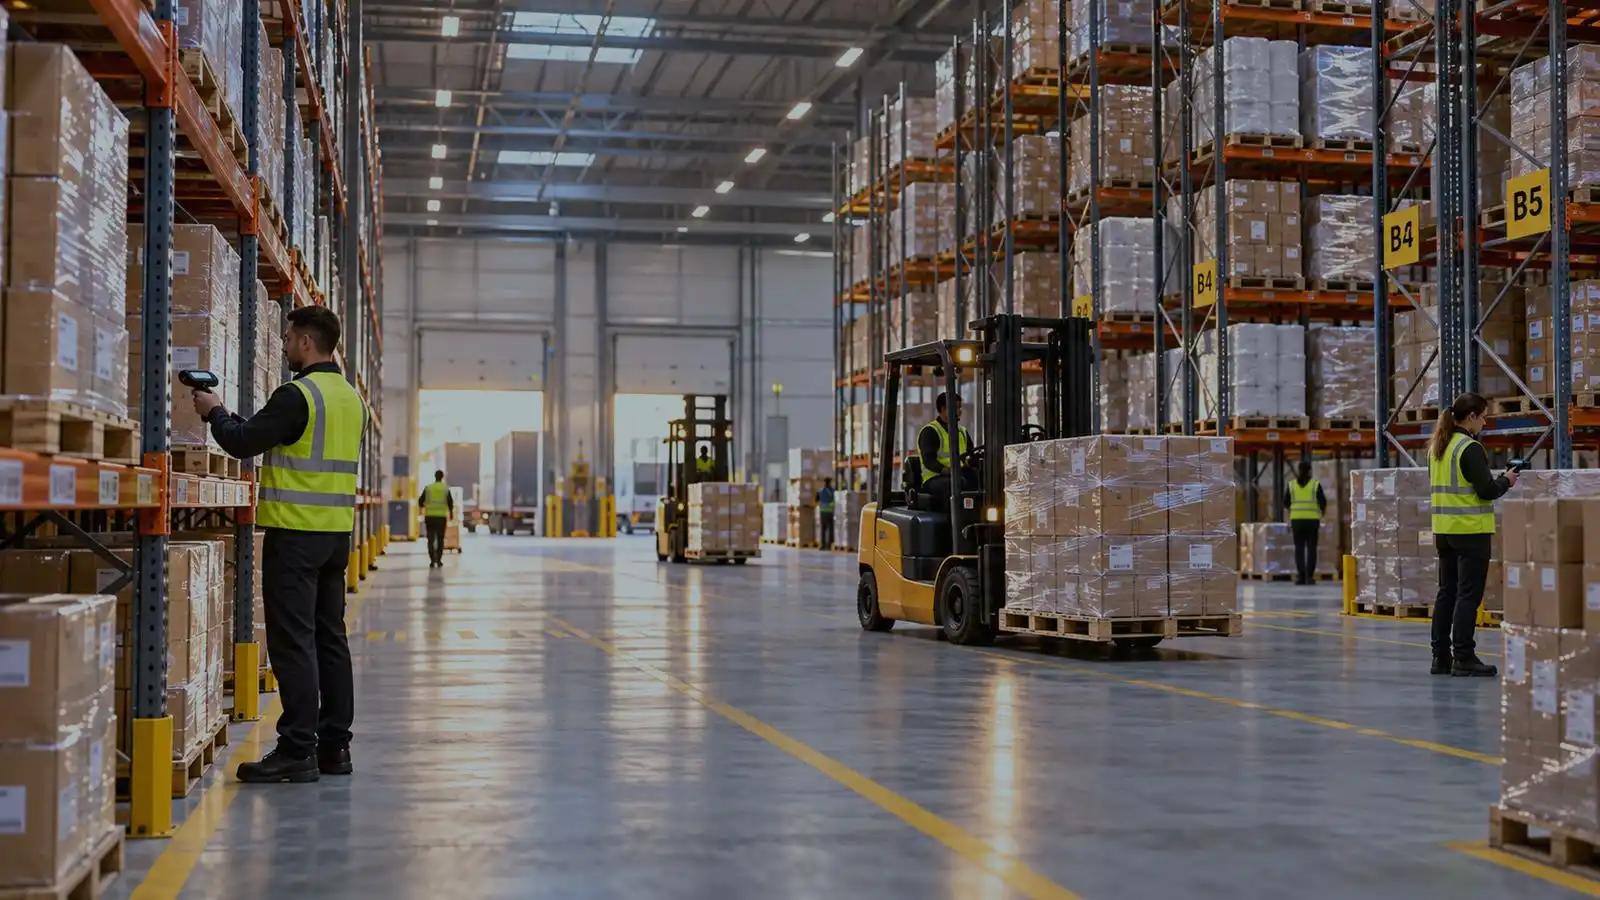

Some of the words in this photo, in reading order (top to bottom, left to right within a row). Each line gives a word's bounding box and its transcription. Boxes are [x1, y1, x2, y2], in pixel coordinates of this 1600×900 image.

[1514, 184, 1543, 222] B5
[1390, 220, 1414, 252] B4
[1197, 269, 1212, 295] B4
